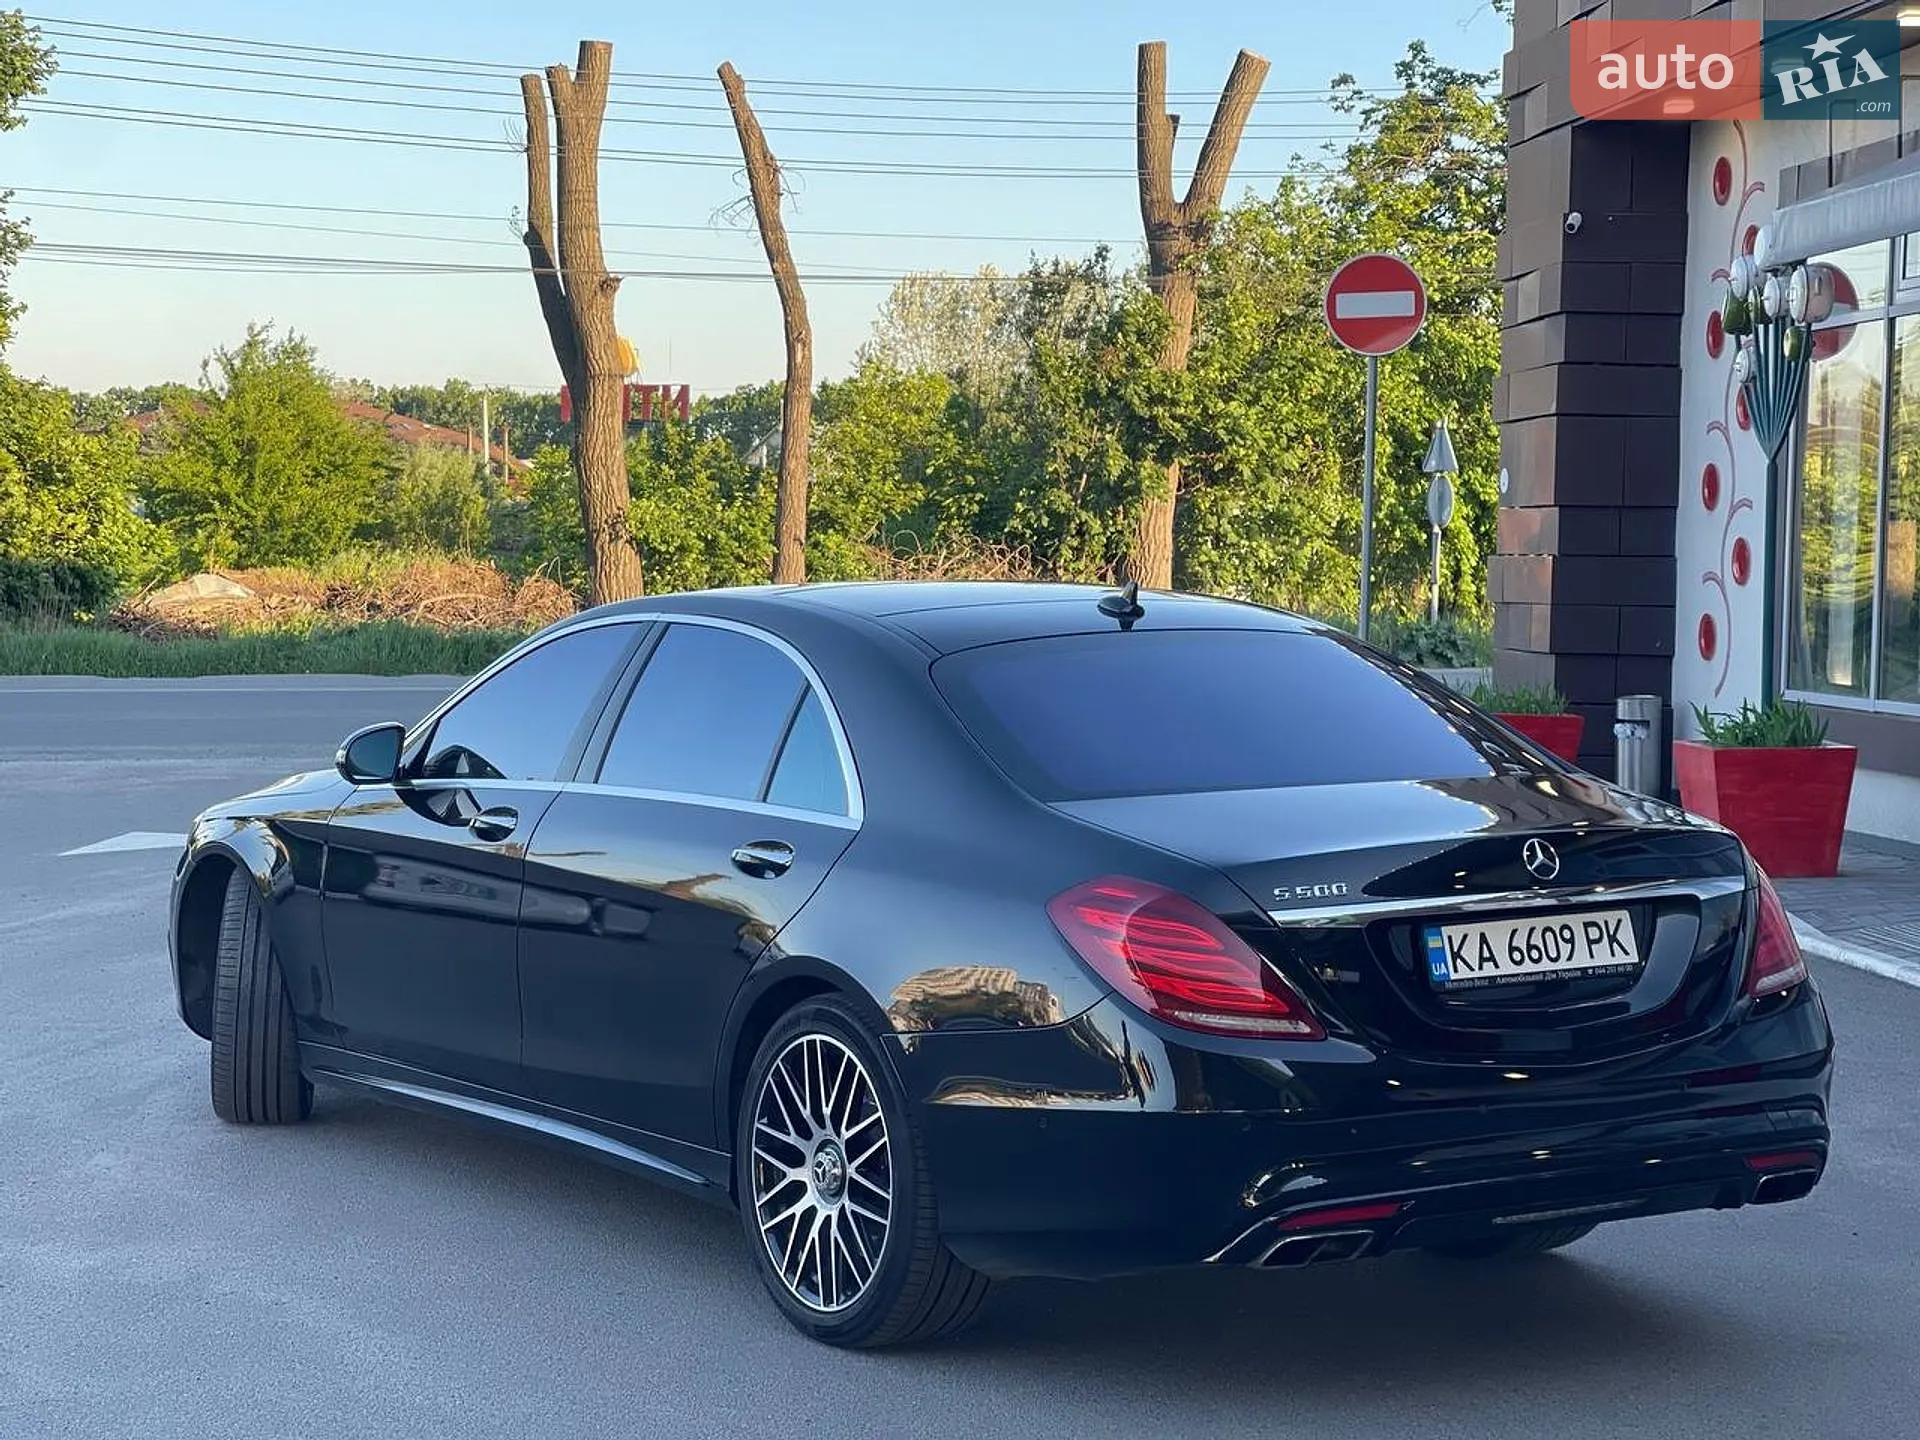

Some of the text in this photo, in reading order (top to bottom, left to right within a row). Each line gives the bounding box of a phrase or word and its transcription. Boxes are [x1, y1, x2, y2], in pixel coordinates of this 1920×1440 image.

[1273, 883, 1348, 901] S 500
[1447, 918, 1630, 973] KA 6609 PK
[1432, 963, 1448, 975] UA
